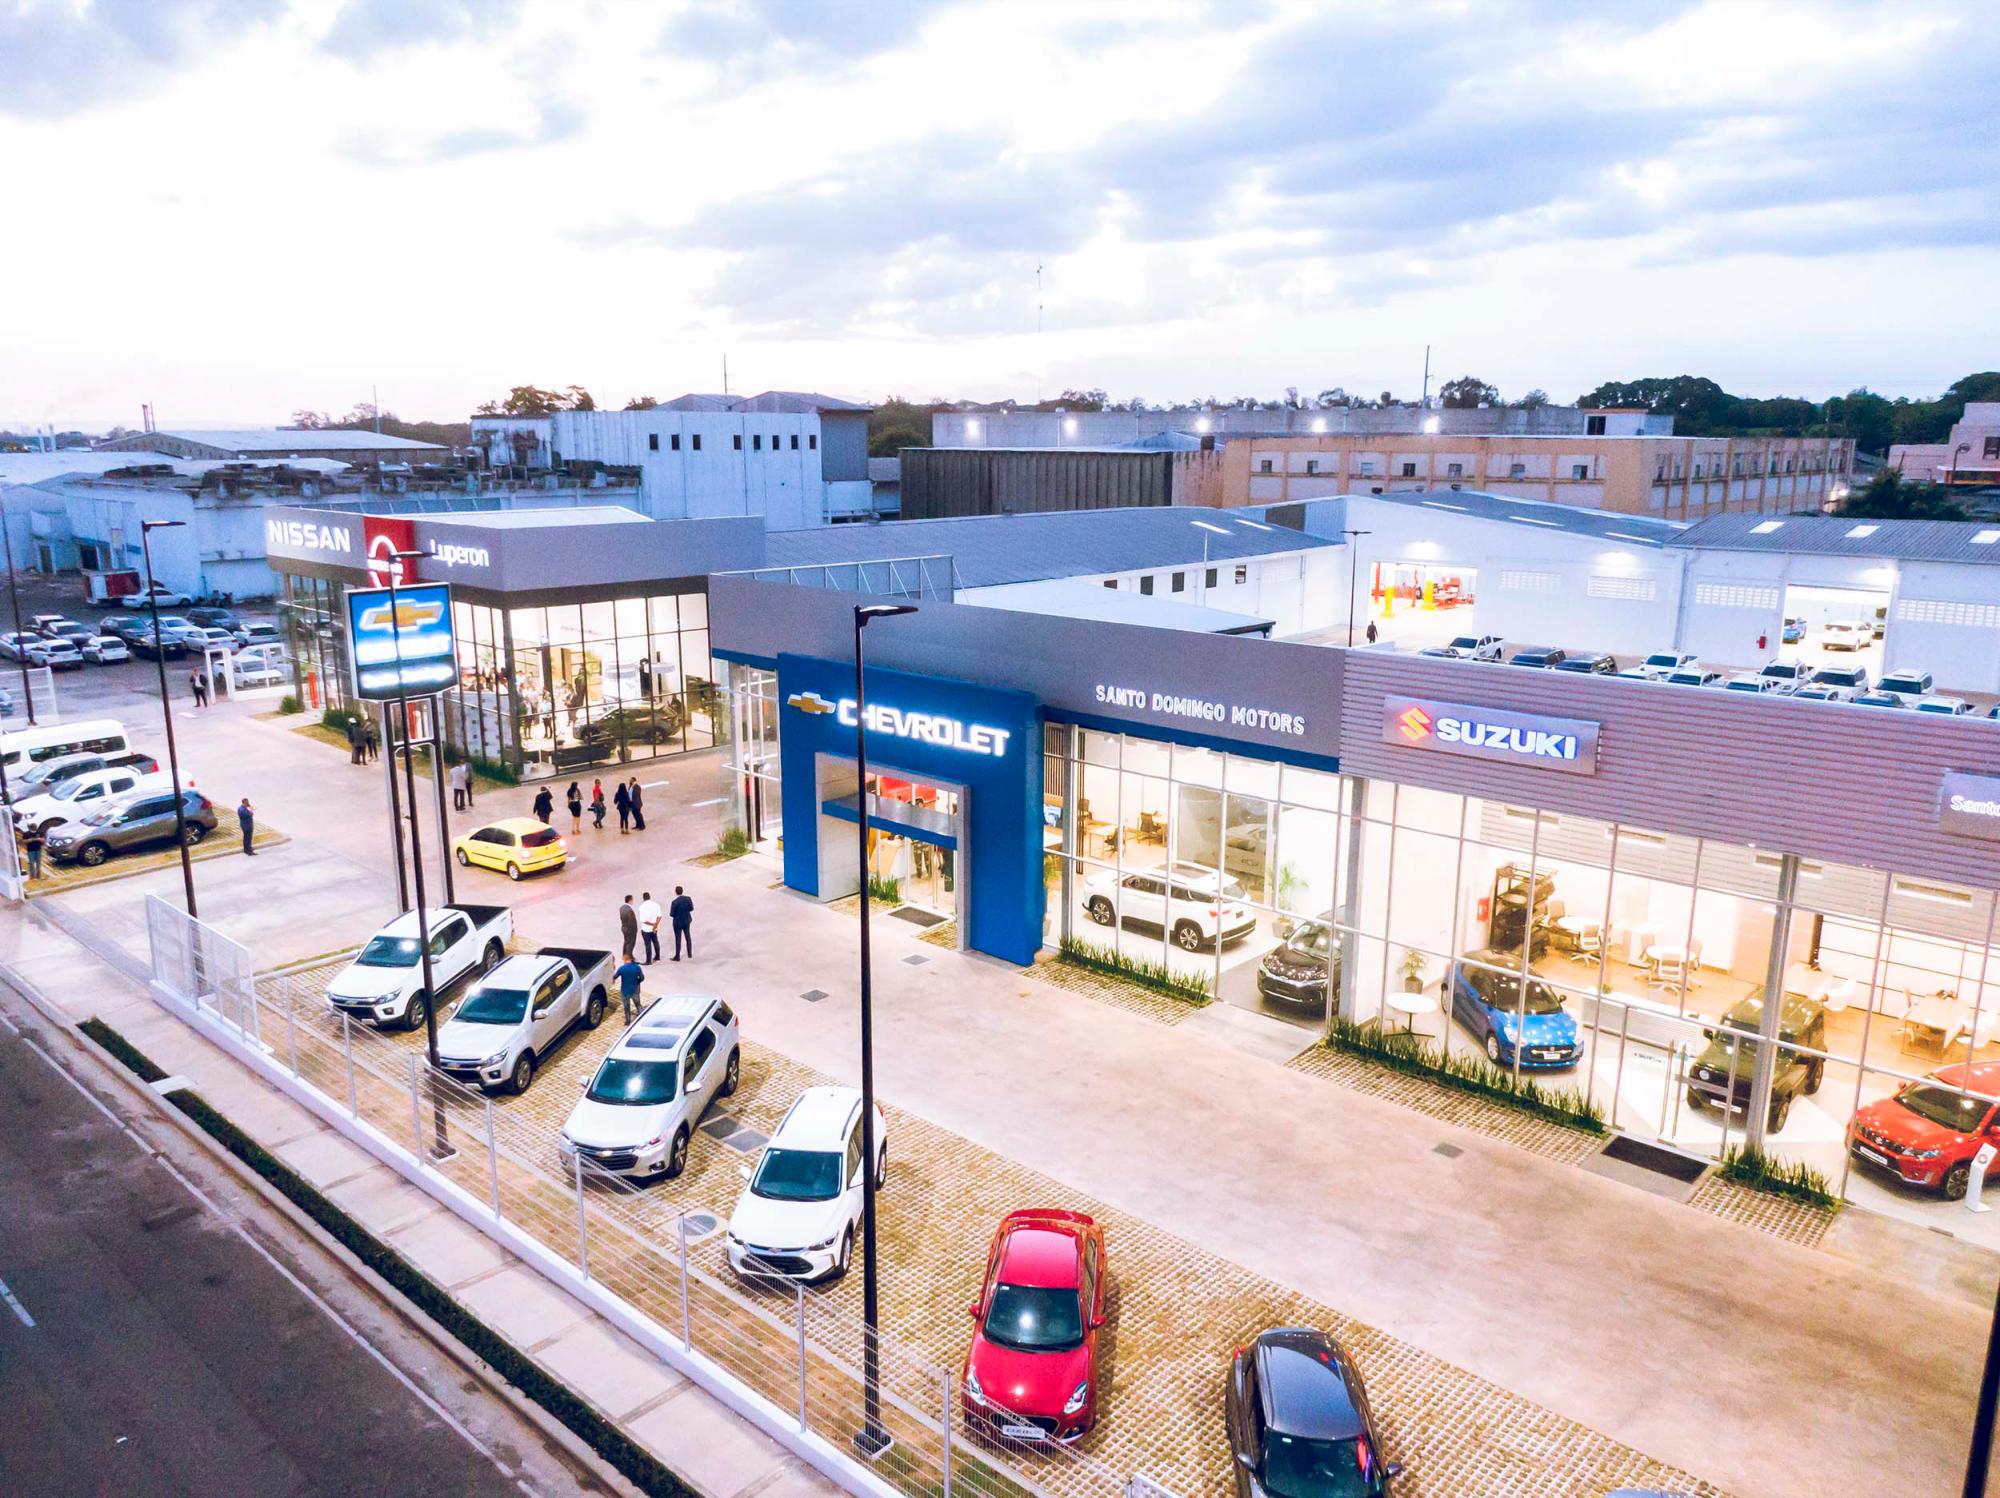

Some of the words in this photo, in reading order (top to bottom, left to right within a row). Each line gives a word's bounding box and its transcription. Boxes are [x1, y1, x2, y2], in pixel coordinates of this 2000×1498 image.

[267, 519, 351, 553] NISSAN
[430, 538, 490, 568] Luperon
[1095, 684, 1146, 708] SANTO
[1152, 693, 1226, 722] DOMINGO
[1231, 705, 1305, 735] MOTORS
[1436, 718, 1577, 760] SUZUKI
